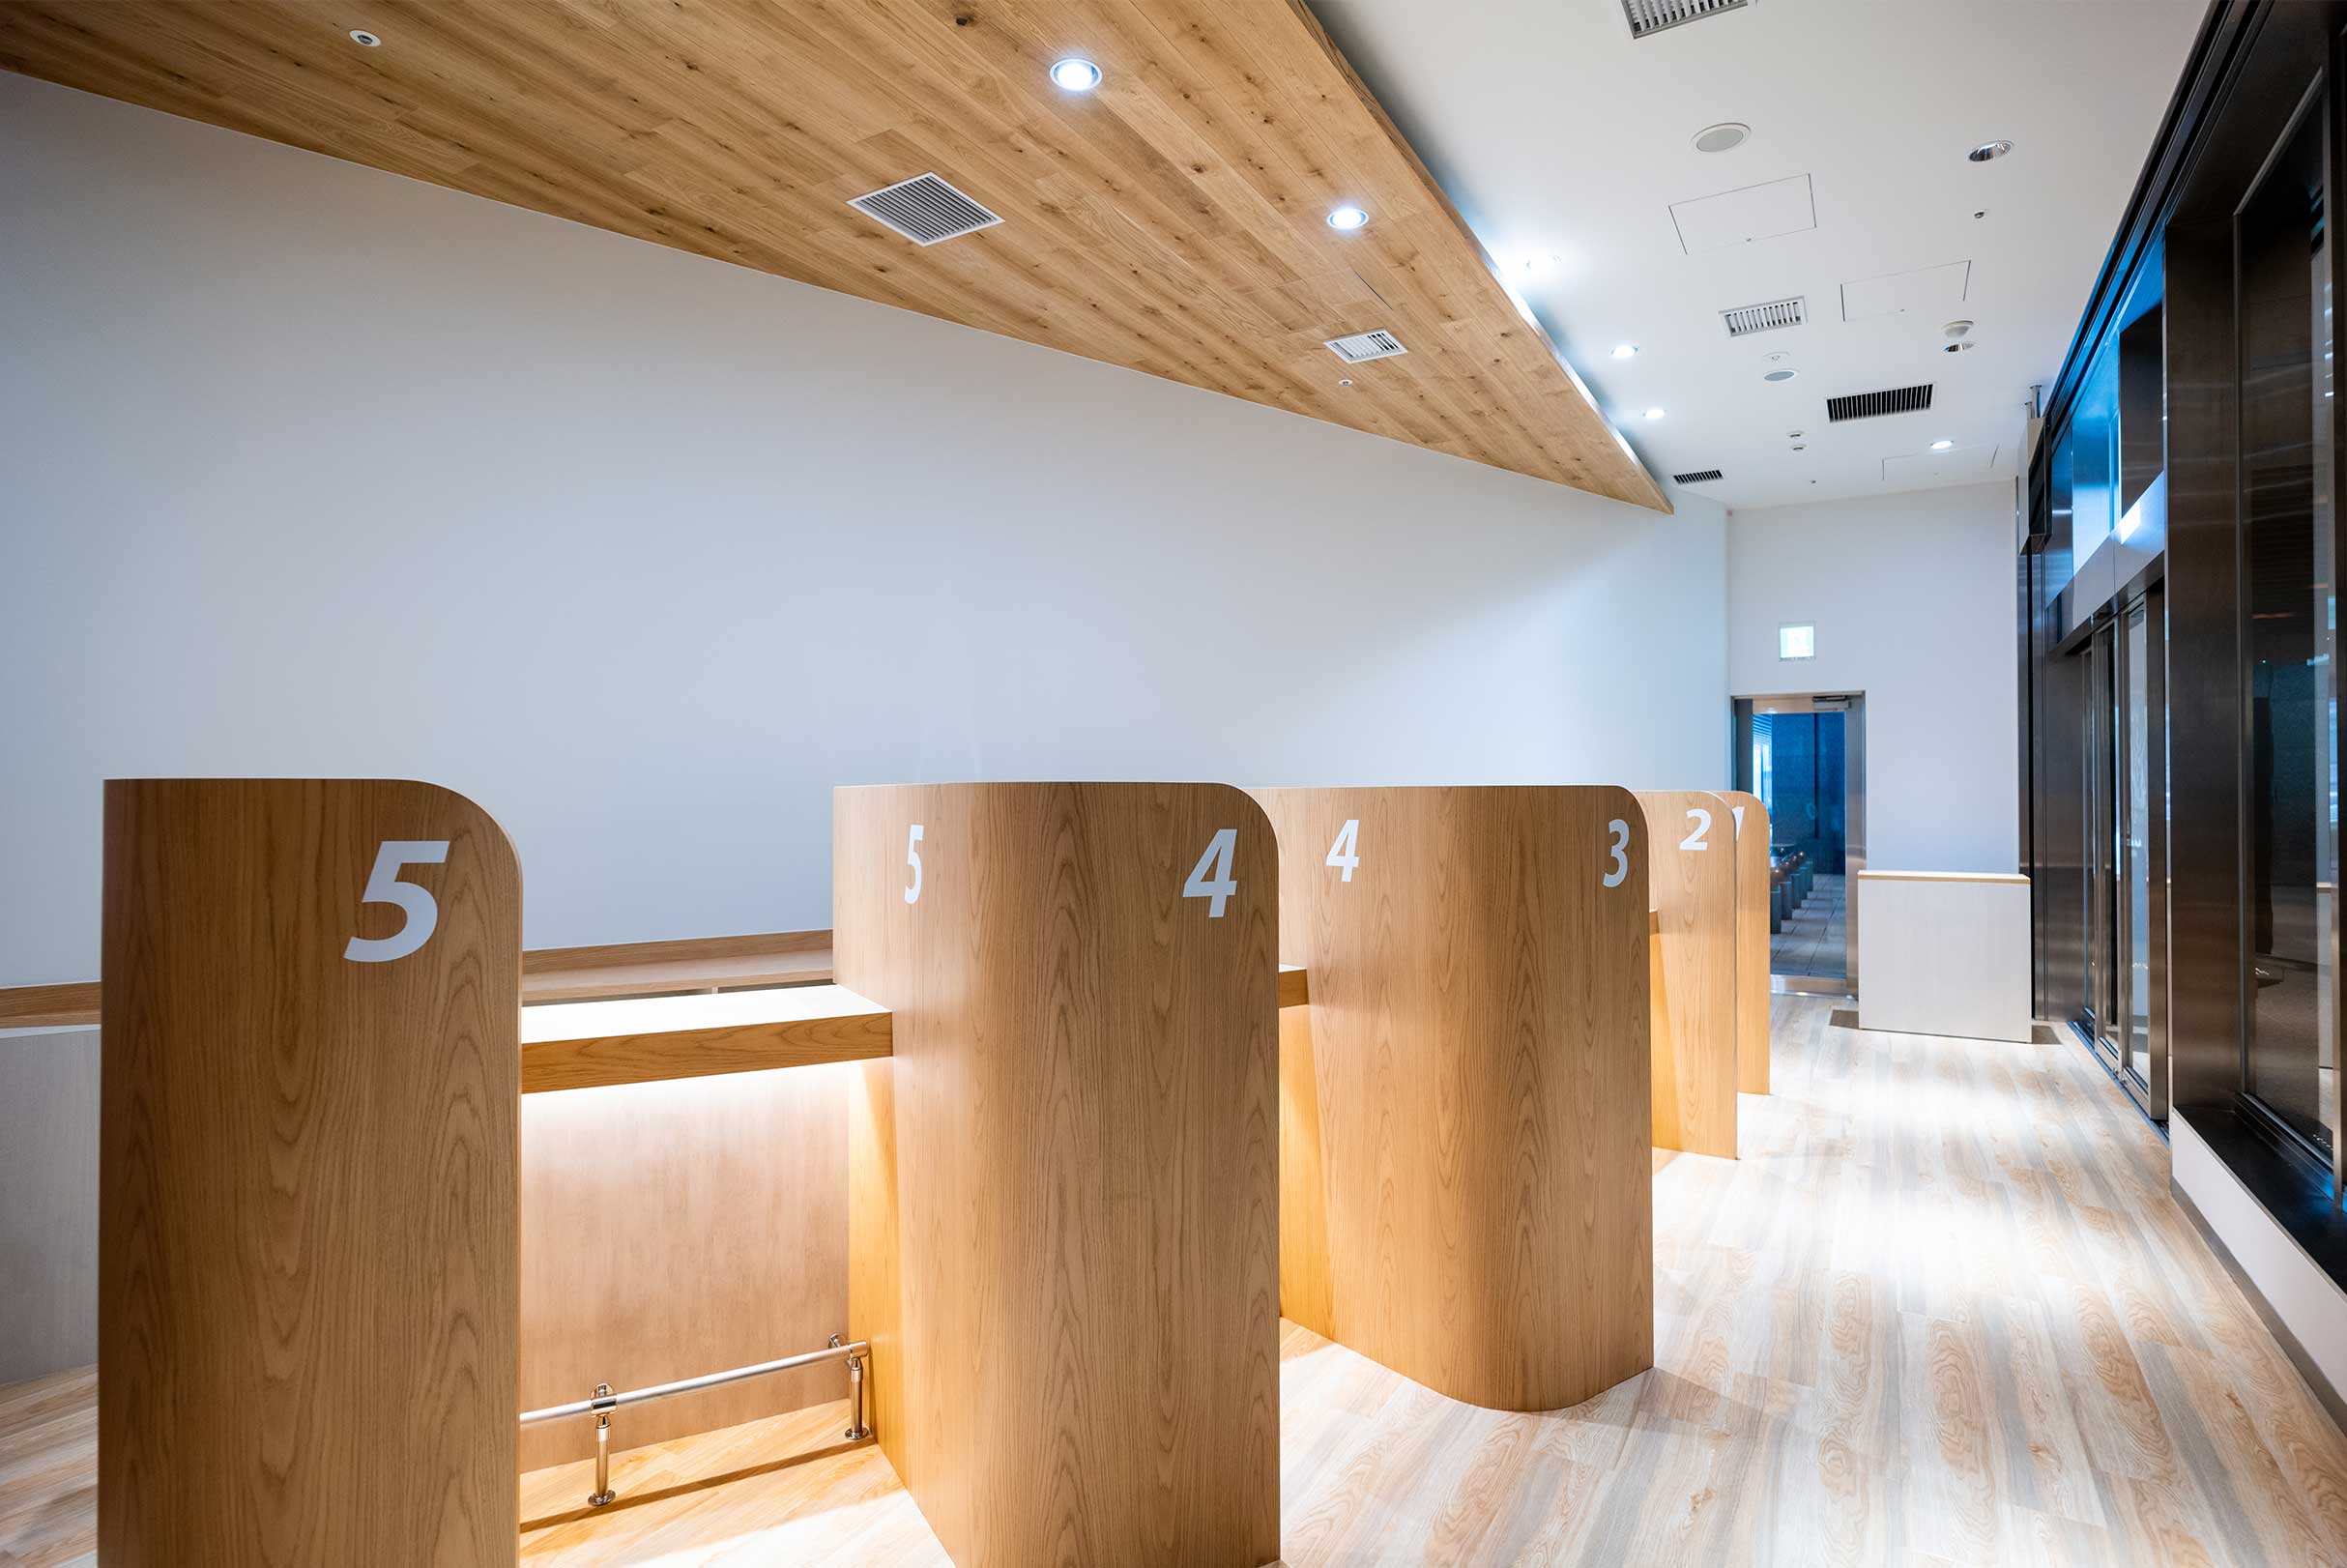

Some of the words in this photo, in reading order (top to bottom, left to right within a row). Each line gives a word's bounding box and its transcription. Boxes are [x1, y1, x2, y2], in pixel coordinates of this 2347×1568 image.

[903, 824, 925, 905] 5
[1325, 819, 1360, 883] 4
[1602, 819, 1630, 888] 3
[1678, 808, 1713, 852] 2
[343, 839, 450, 963] 5
[1181, 828, 1238, 918] 4
